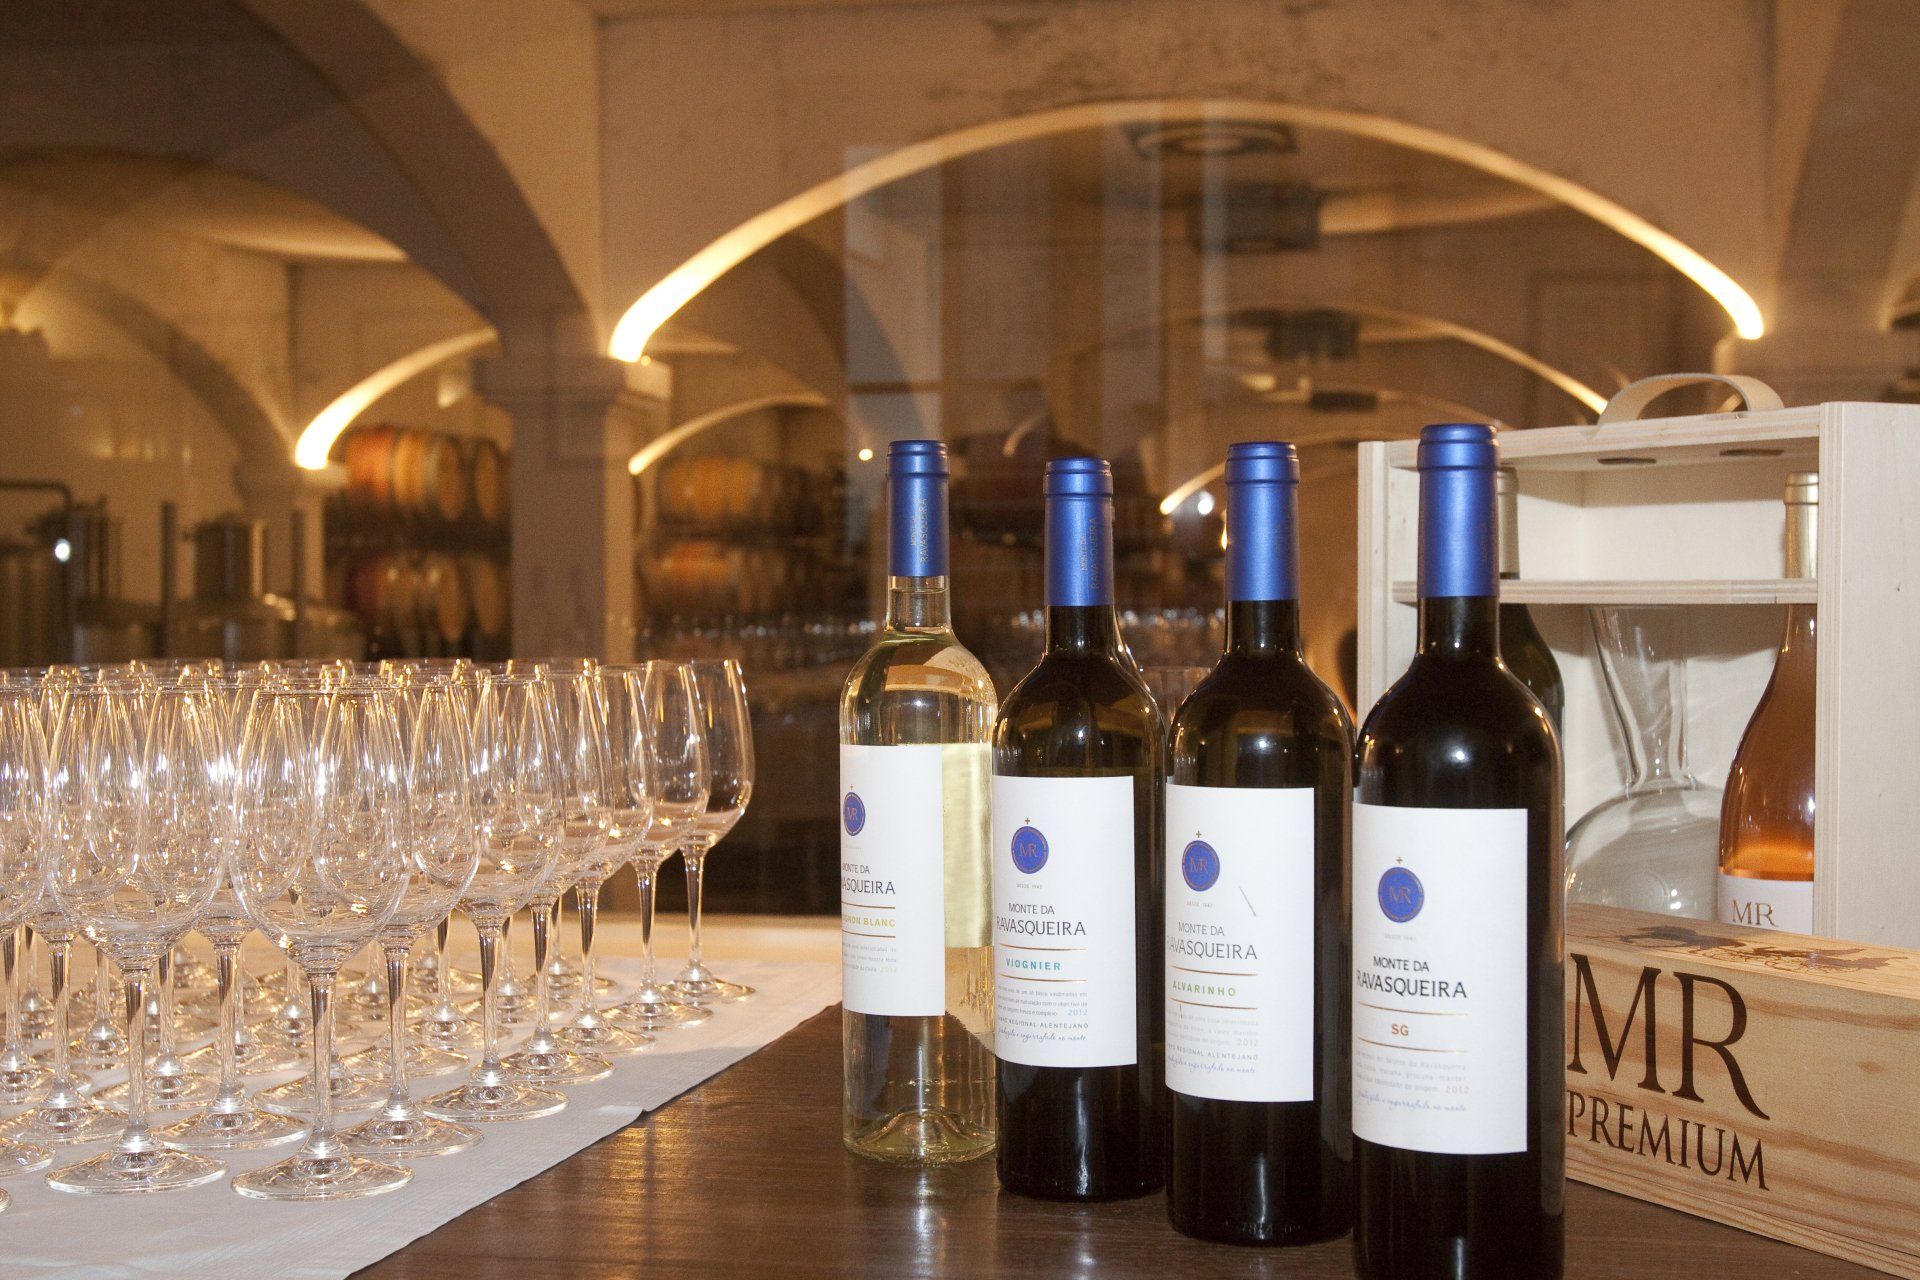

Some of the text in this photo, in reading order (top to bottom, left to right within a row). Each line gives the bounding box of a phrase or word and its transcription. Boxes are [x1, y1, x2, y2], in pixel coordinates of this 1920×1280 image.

[1019, 842, 1037, 858] MR
[860, 864, 870, 874] DA
[1190, 857, 1208, 873] MR
[1388, 885, 1412, 905] MR
[1008, 902, 1055, 915] MONTE DA
[1732, 899, 1779, 927] MR
[863, 917, 896, 928] BLANC
[1178, 921, 1225, 937] MONTE DA
[1005, 957, 1062, 971] VIOGNIER
[1373, 955, 1430, 972] MONTE DA
[1172, 980, 1236, 997] ALVARINHO
[1356, 969, 1468, 998] RAVASQUEIRA
[1067, 1008, 1088, 1016] 2012
[1391, 1023, 1409, 1037] SG
[1566, 952, 1770, 1120] MR
[1207, 1051, 1259, 1061] ALENTEJANO
[1446, 1085, 1470, 1094] 2012
[1566, 1089, 1770, 1192] PREMIUM
